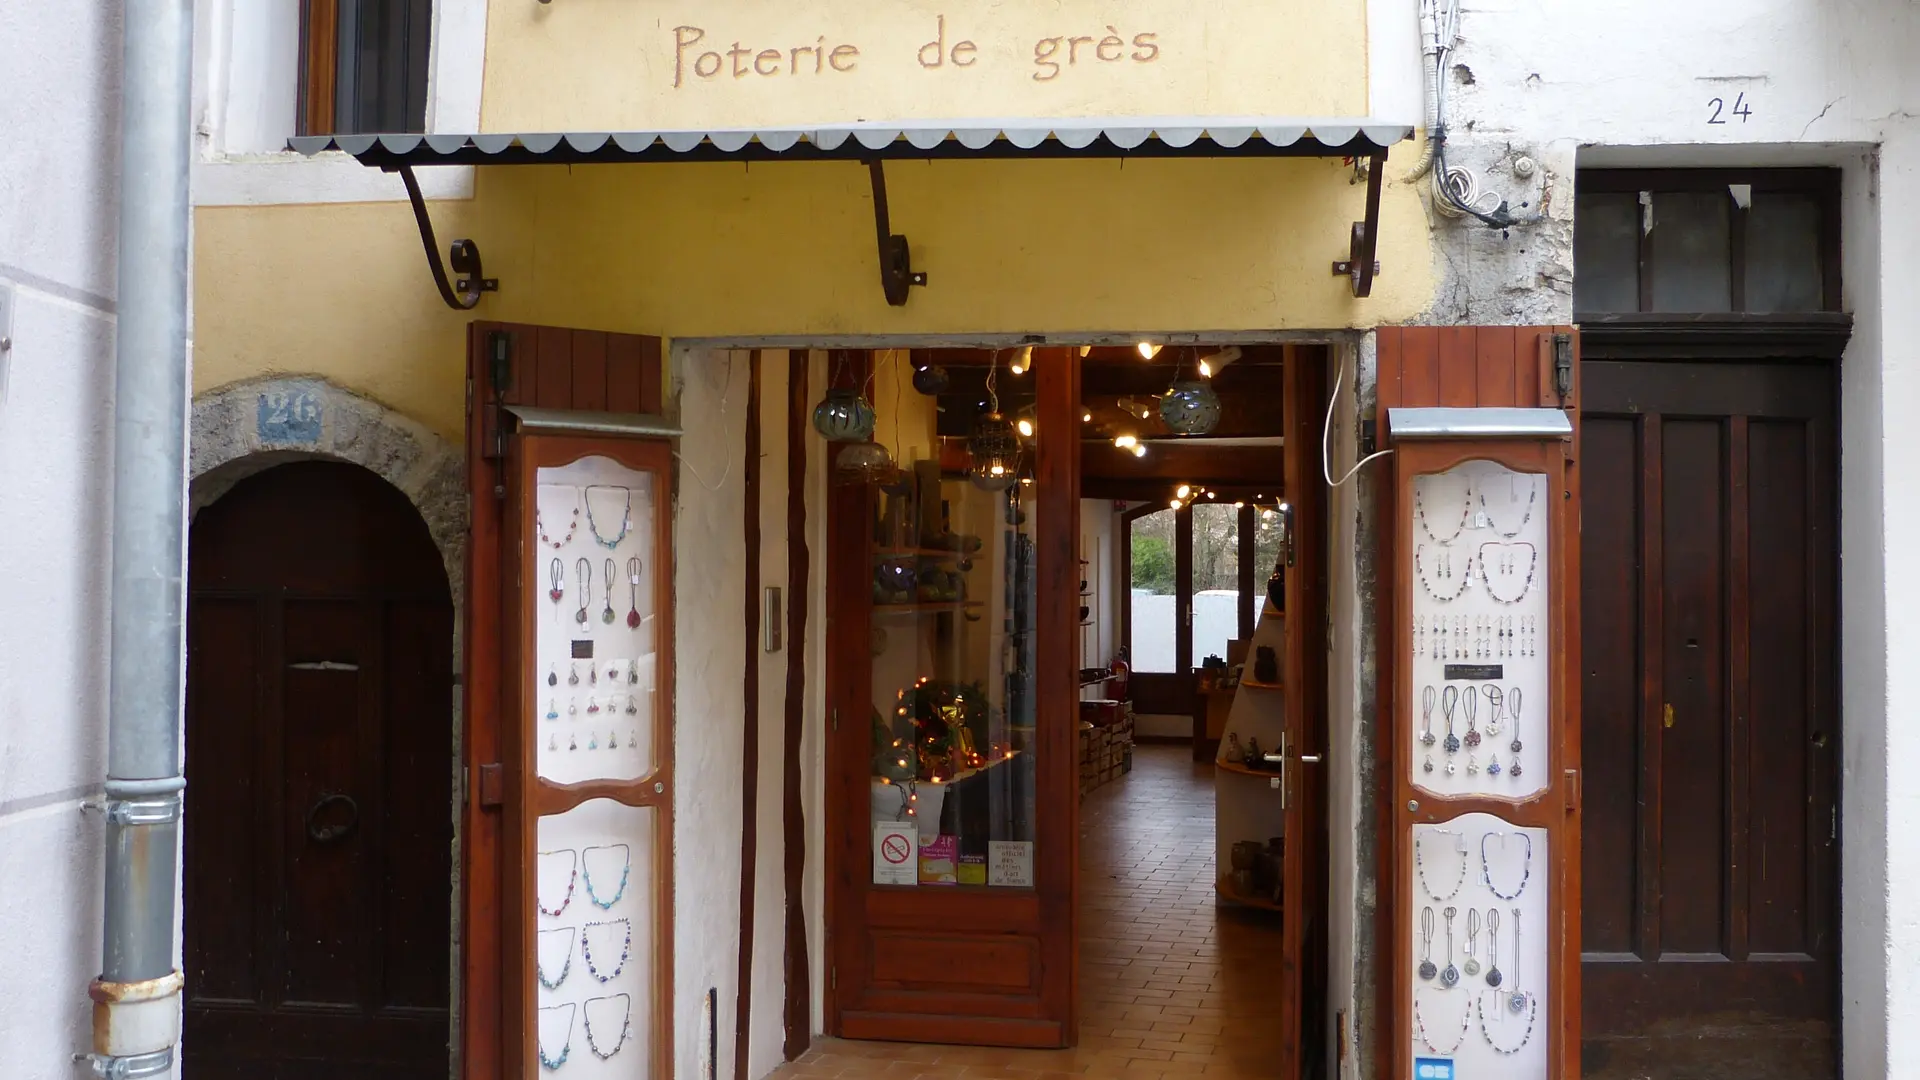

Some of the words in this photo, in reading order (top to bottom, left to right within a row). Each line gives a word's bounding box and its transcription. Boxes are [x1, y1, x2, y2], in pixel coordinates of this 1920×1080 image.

[673, 25, 860, 89] Poterie
[917, 14, 978, 69] de
[1033, 25, 1160, 82] grès
[1707, 91, 1753, 124] 24
[266, 391, 319, 424] 26
